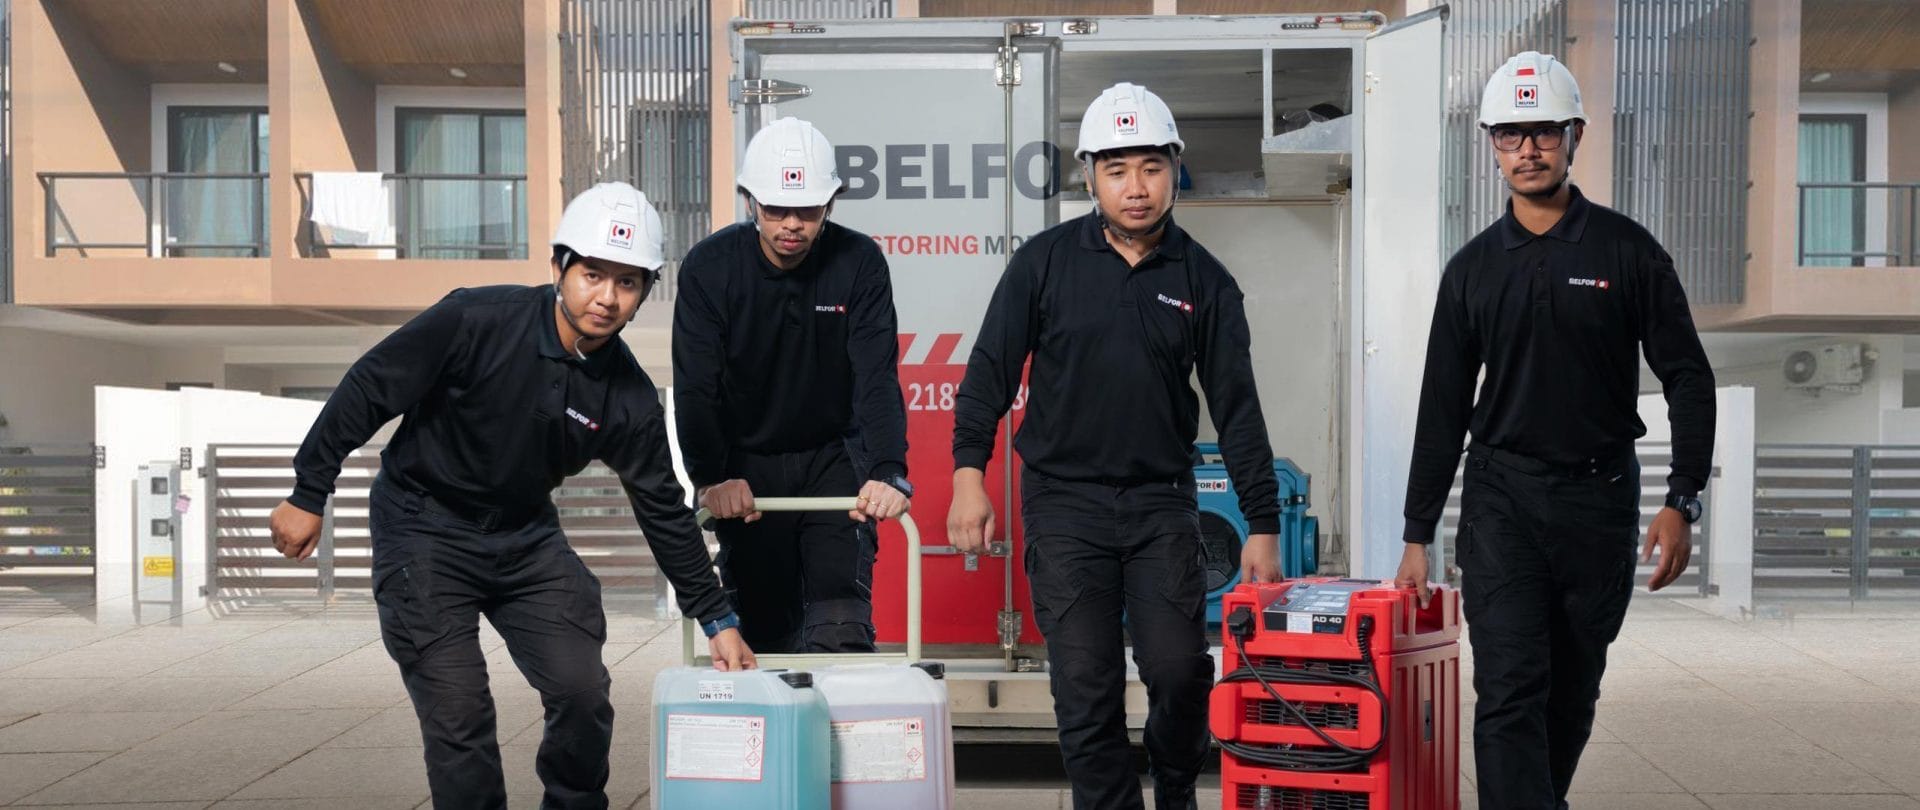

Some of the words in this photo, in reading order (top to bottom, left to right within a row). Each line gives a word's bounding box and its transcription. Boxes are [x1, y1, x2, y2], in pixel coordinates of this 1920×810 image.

[1157, 293, 1182, 307] BELFOR
[908, 382, 960, 411] 218
[1313, 616, 1328, 624] AD
[699, 692, 711, 700] UN
